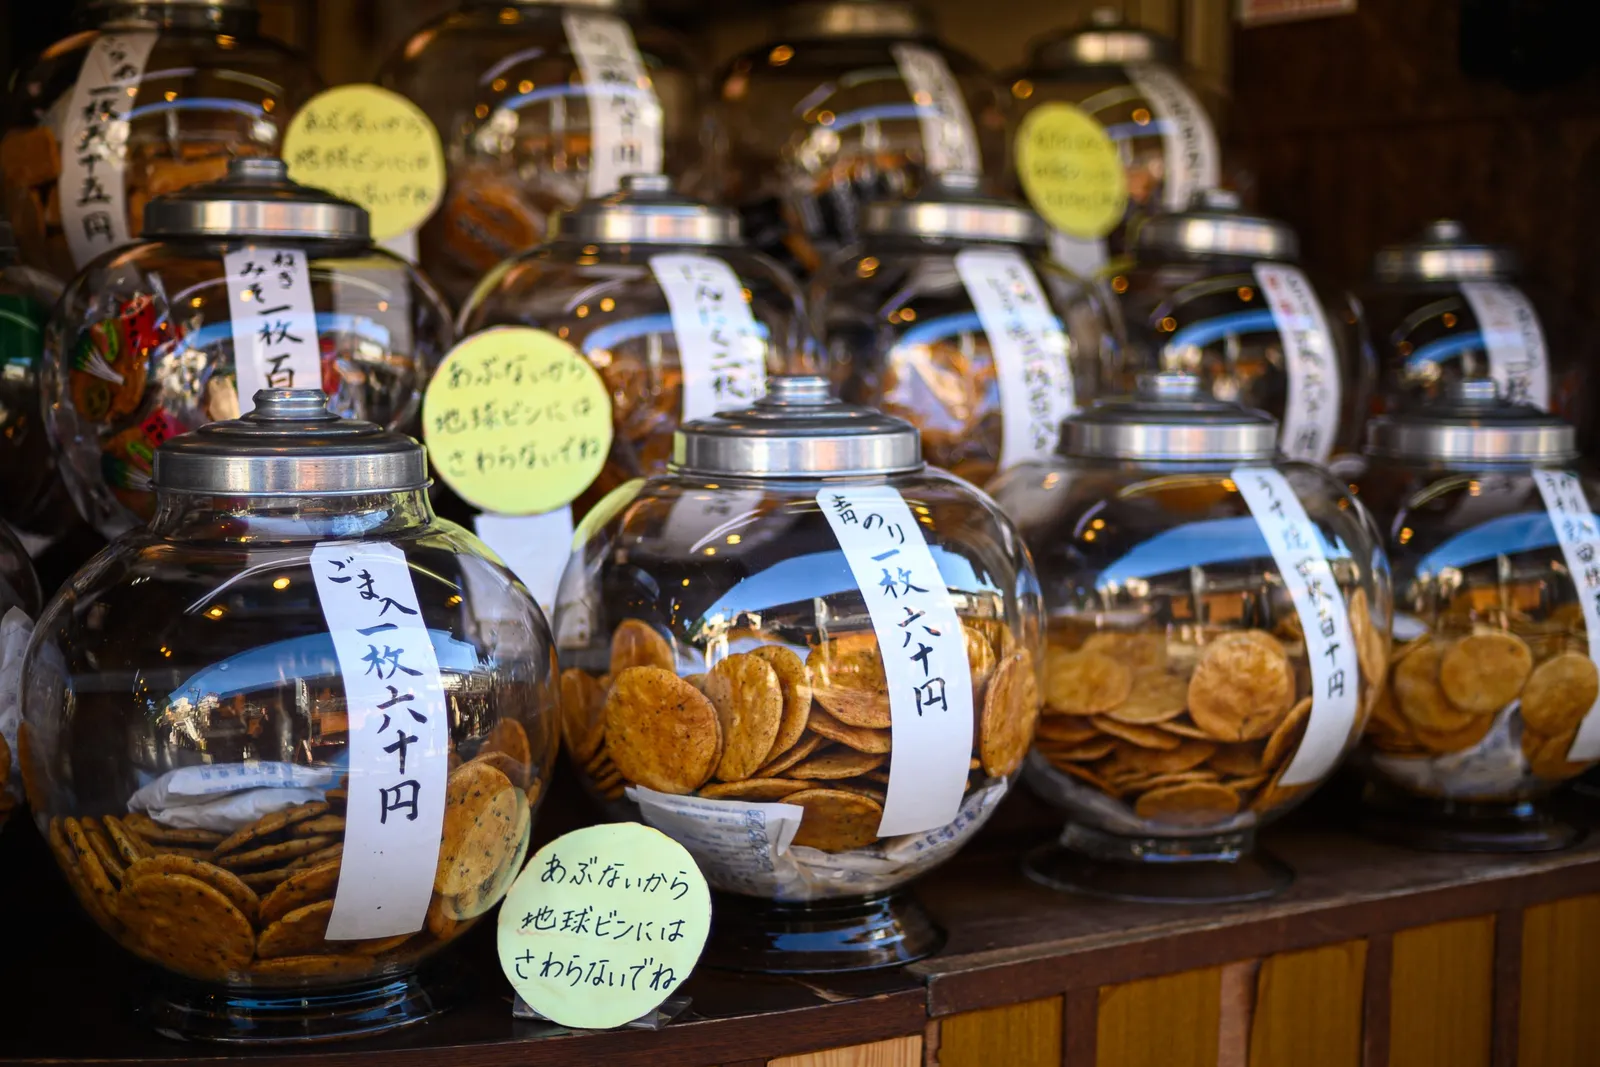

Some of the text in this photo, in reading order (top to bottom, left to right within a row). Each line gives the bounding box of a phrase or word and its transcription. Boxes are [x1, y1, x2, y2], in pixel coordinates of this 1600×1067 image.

[448, 354, 587, 389] あぶないから
[831, 494, 948, 717] 青のり一枚六十円
[327, 555, 427, 826] ごま入一枚六十円
[540, 853, 690, 901] あぶないから
[521, 905, 687, 942] 地球ビンには
[514, 949, 677, 991] さわらないでね
